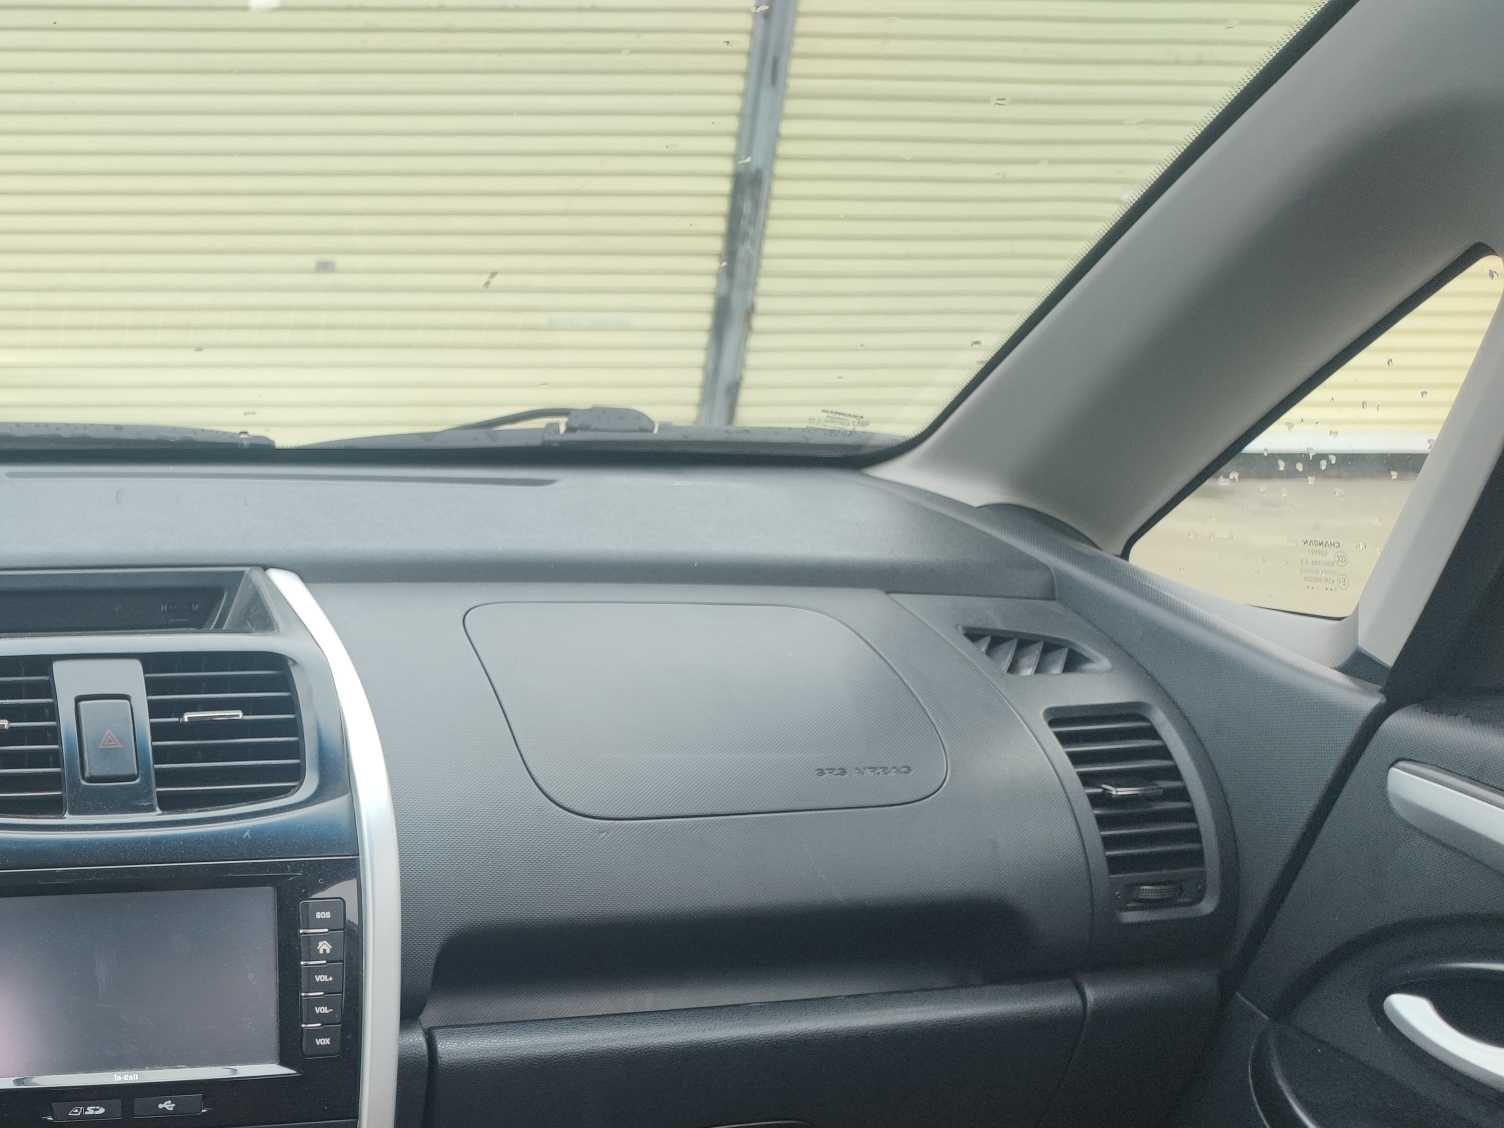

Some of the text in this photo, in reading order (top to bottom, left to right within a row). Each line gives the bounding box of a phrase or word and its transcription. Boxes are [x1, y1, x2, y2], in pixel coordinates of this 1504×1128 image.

[314, 974, 333, 983] VOL+
[314, 1006, 334, 1014] VOL-
[315, 1037, 331, 1046] VOX
